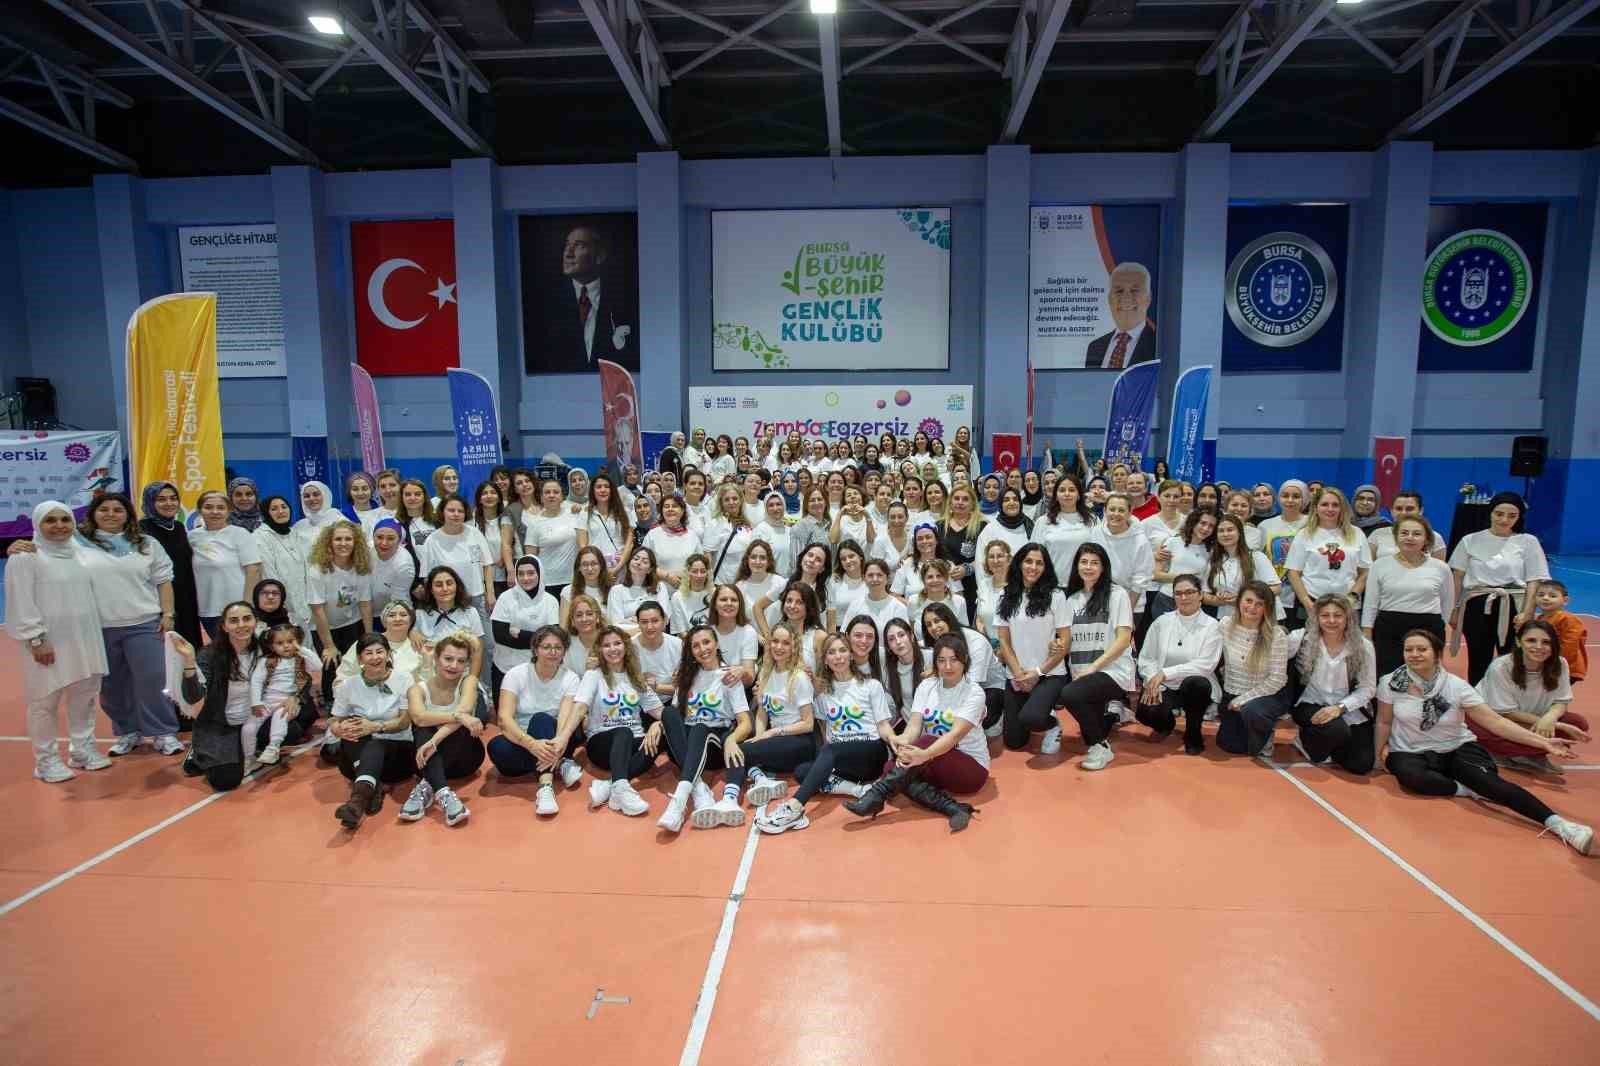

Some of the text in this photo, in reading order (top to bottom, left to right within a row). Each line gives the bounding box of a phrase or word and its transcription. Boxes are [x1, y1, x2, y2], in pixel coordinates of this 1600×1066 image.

[1263, 245, 1304, 260] BURSA
[782, 298, 882, 321] GENÇLİK
[782, 322, 883, 342] KULÜBÜ
[753, 417, 822, 438] Zmba
[828, 416, 909, 440] Egzersiz
[0, 447, 49, 461] ersiz
[183, 447, 207, 491] Spor
